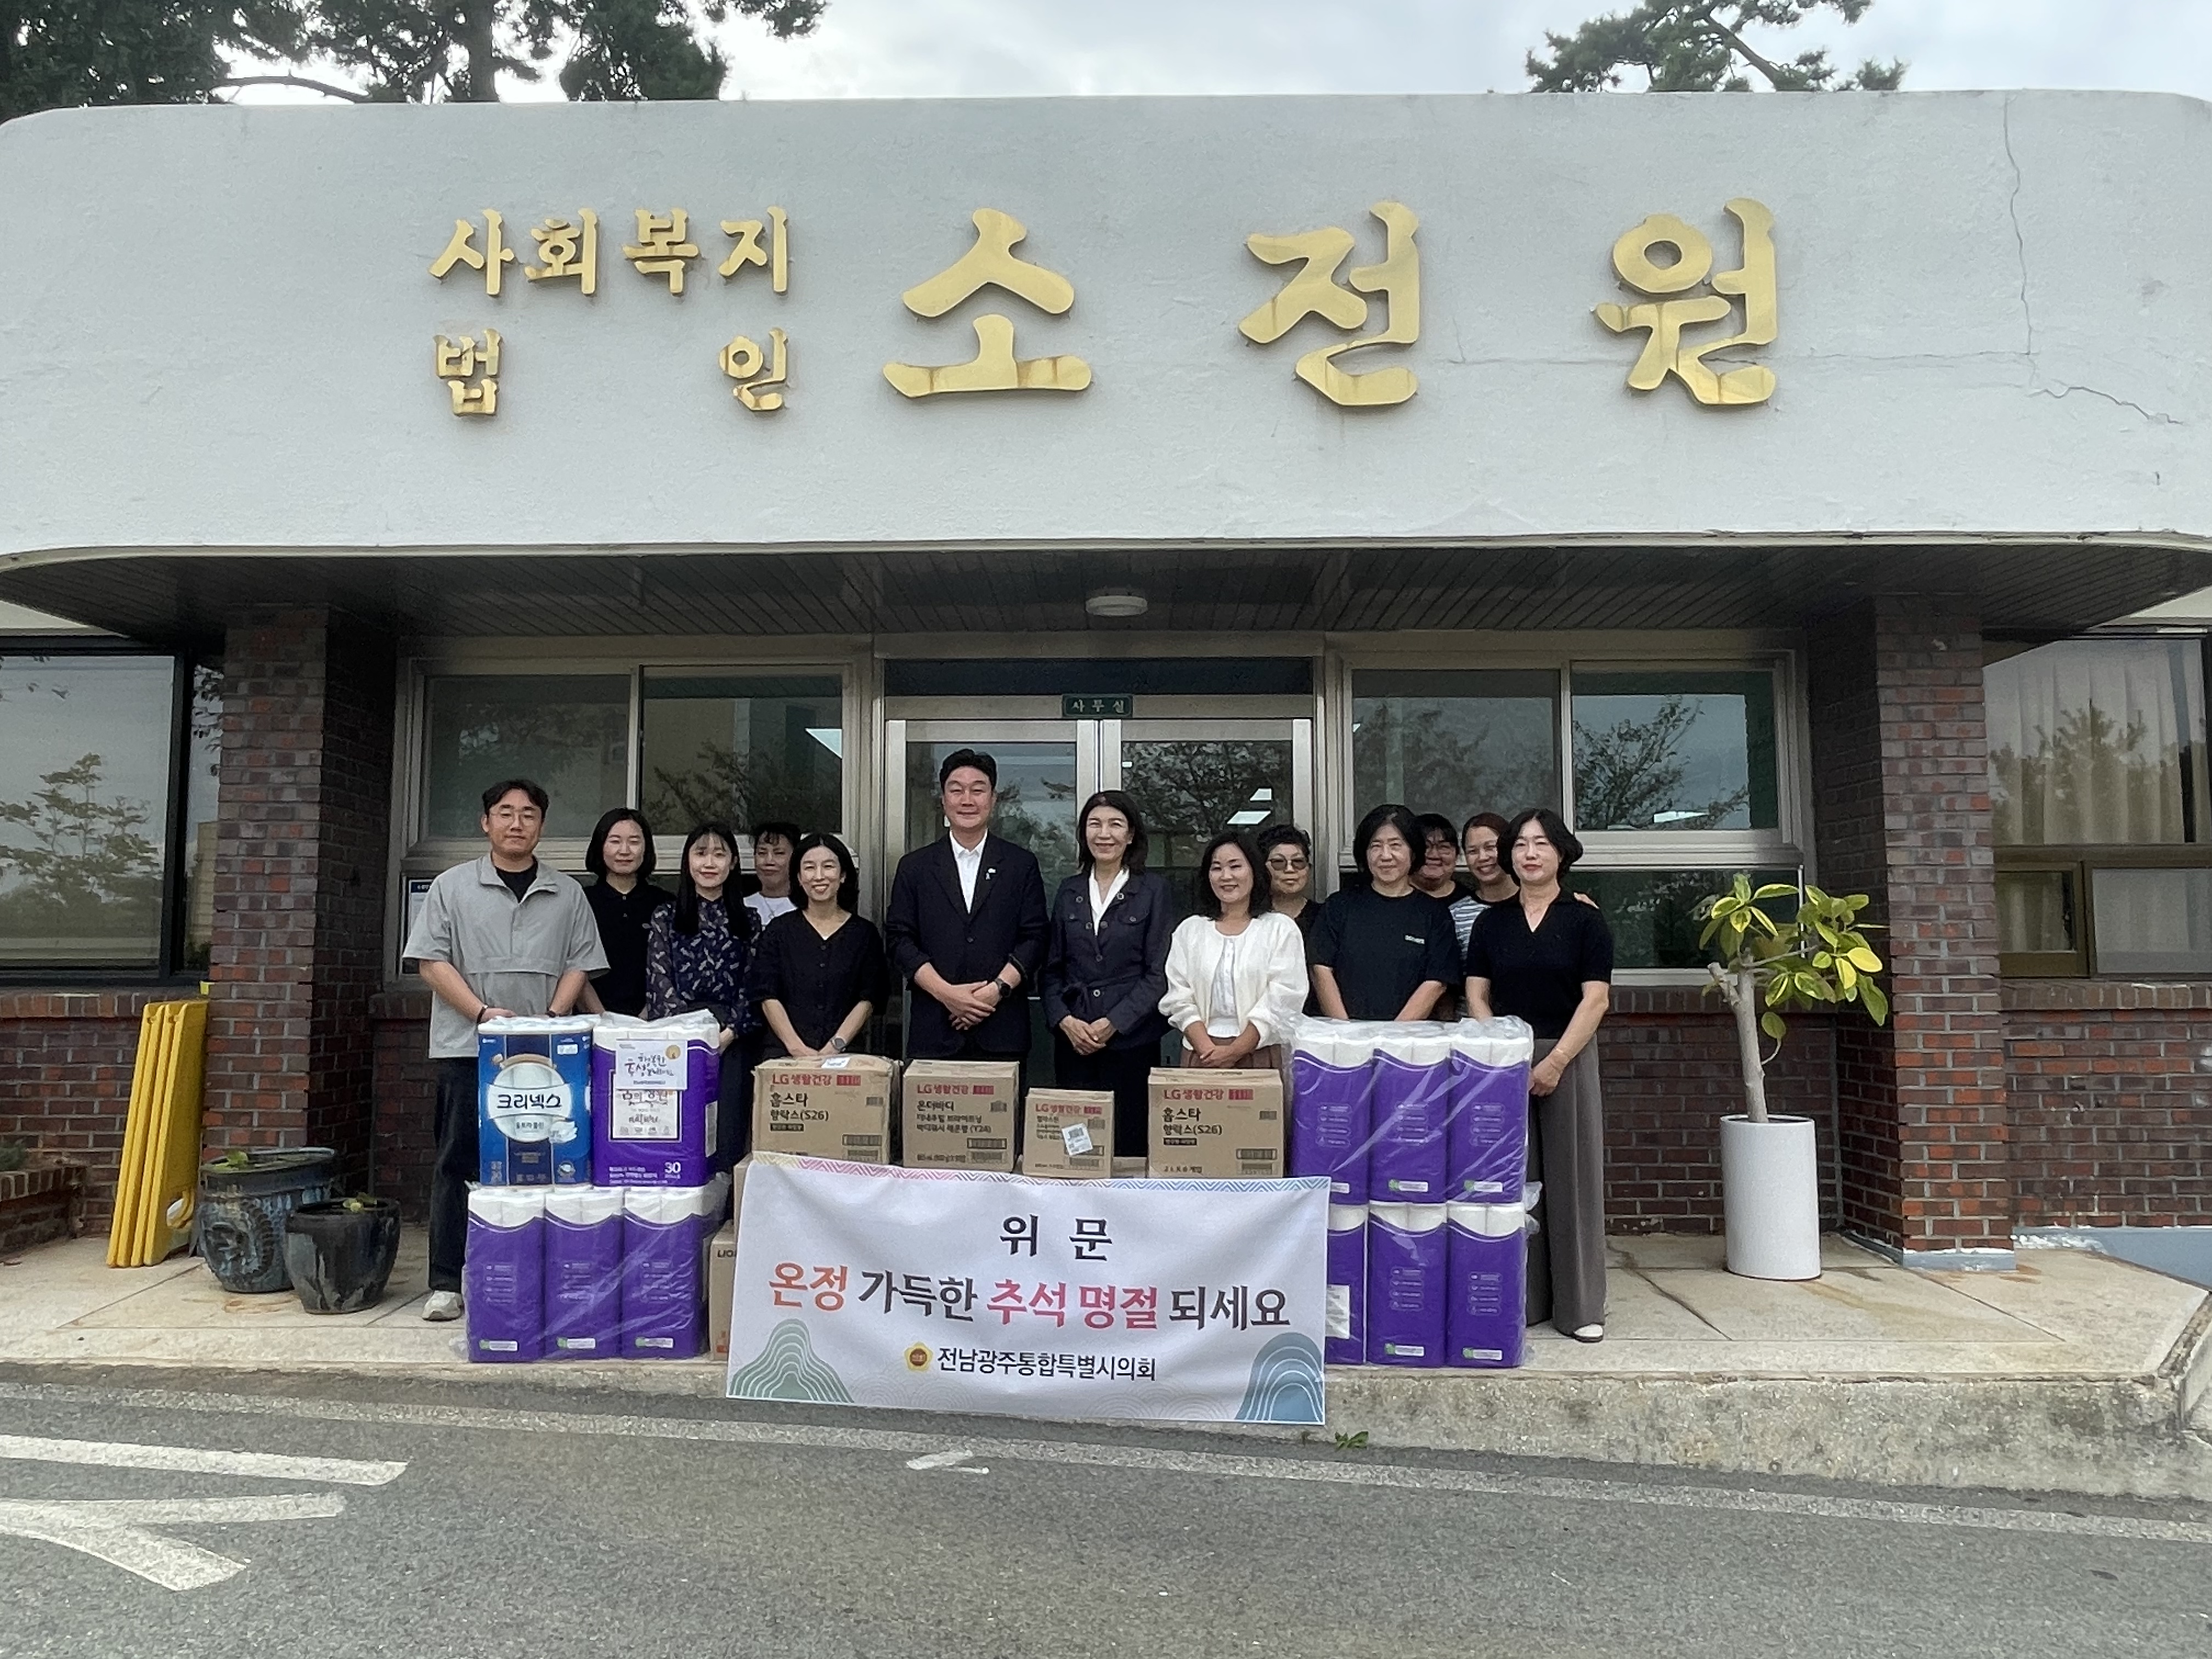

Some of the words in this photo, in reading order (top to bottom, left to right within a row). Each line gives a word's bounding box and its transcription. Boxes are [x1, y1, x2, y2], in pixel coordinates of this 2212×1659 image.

[428, 206, 787, 295] 사회복지
[883, 198, 1776, 405] 소전원
[433, 328, 787, 414] 법인
[1072, 699, 1124, 713] 사무실
[497, 1093, 562, 1110] 크리넥스
[770, 1092, 808, 1108] 홈스타
[1163, 1107, 1201, 1122] 홈스타
[664, 1161, 681, 1173] 30
[769, 1262, 848, 1311] 온정
[859, 1270, 978, 1322] 가득한
[988, 1278, 1066, 1328] 추석
[1080, 1284, 1158, 1330] 명절
[1169, 1286, 1290, 1330] 되세요
[937, 1347, 1156, 1381] 전남광주통합특별시의회
